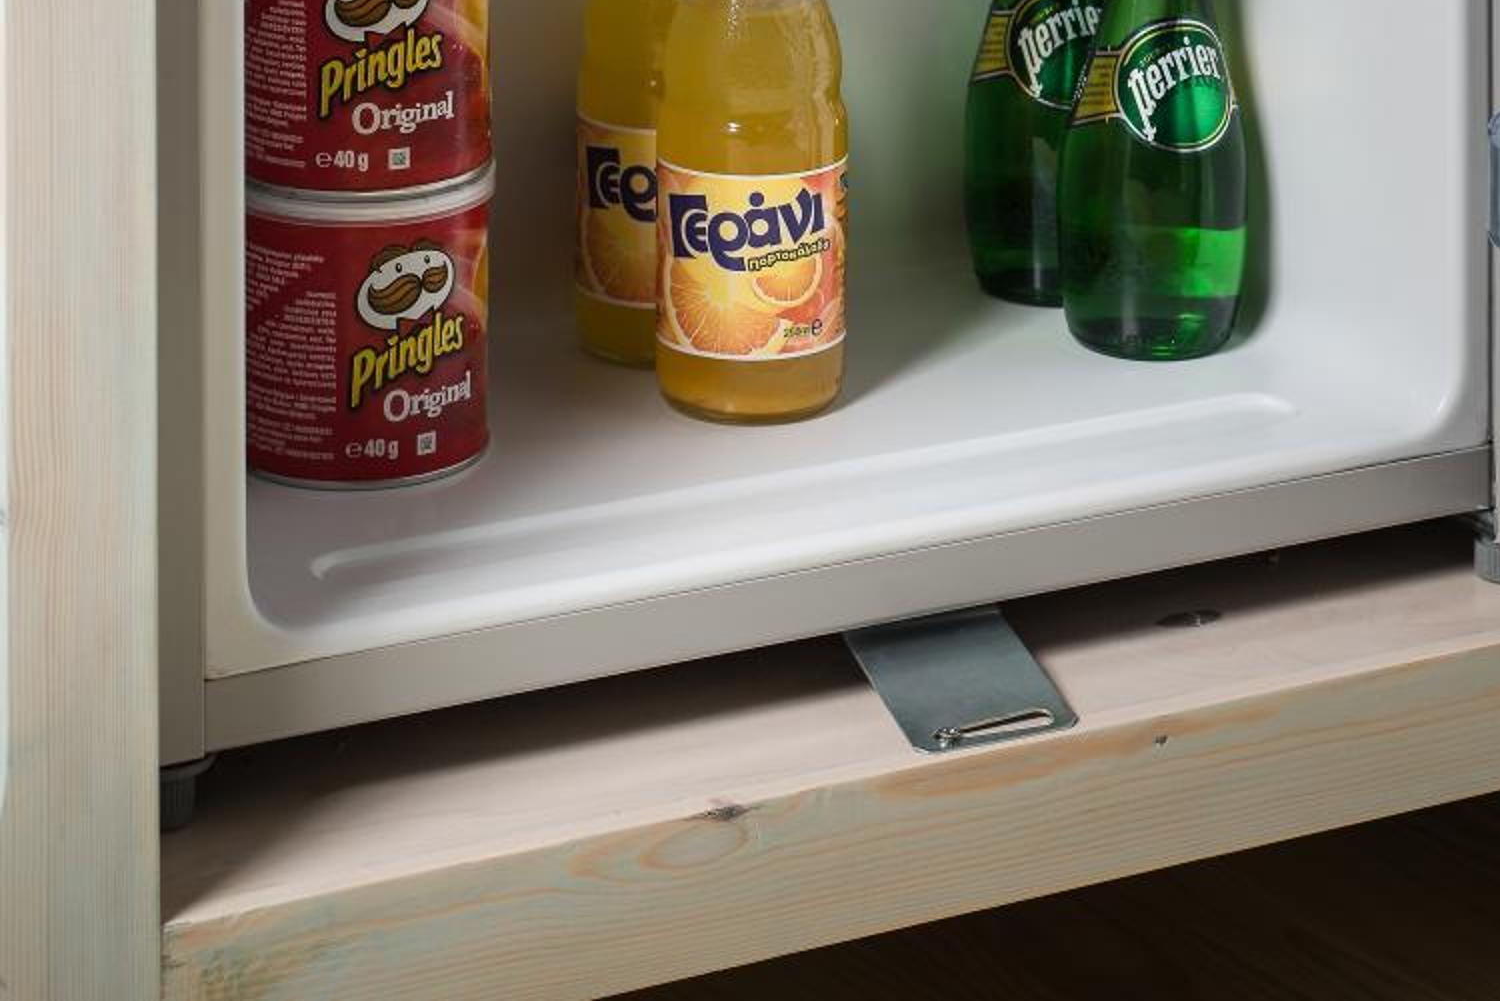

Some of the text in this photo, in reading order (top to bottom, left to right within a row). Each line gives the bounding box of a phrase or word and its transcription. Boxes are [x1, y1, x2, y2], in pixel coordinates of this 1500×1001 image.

[320, 28, 443, 118] Pringles
[352, 91, 454, 135] Original
[668, 188, 825, 272] Γεράνι
[351, 313, 464, 409] Pringles
[383, 371, 472, 422] Original
